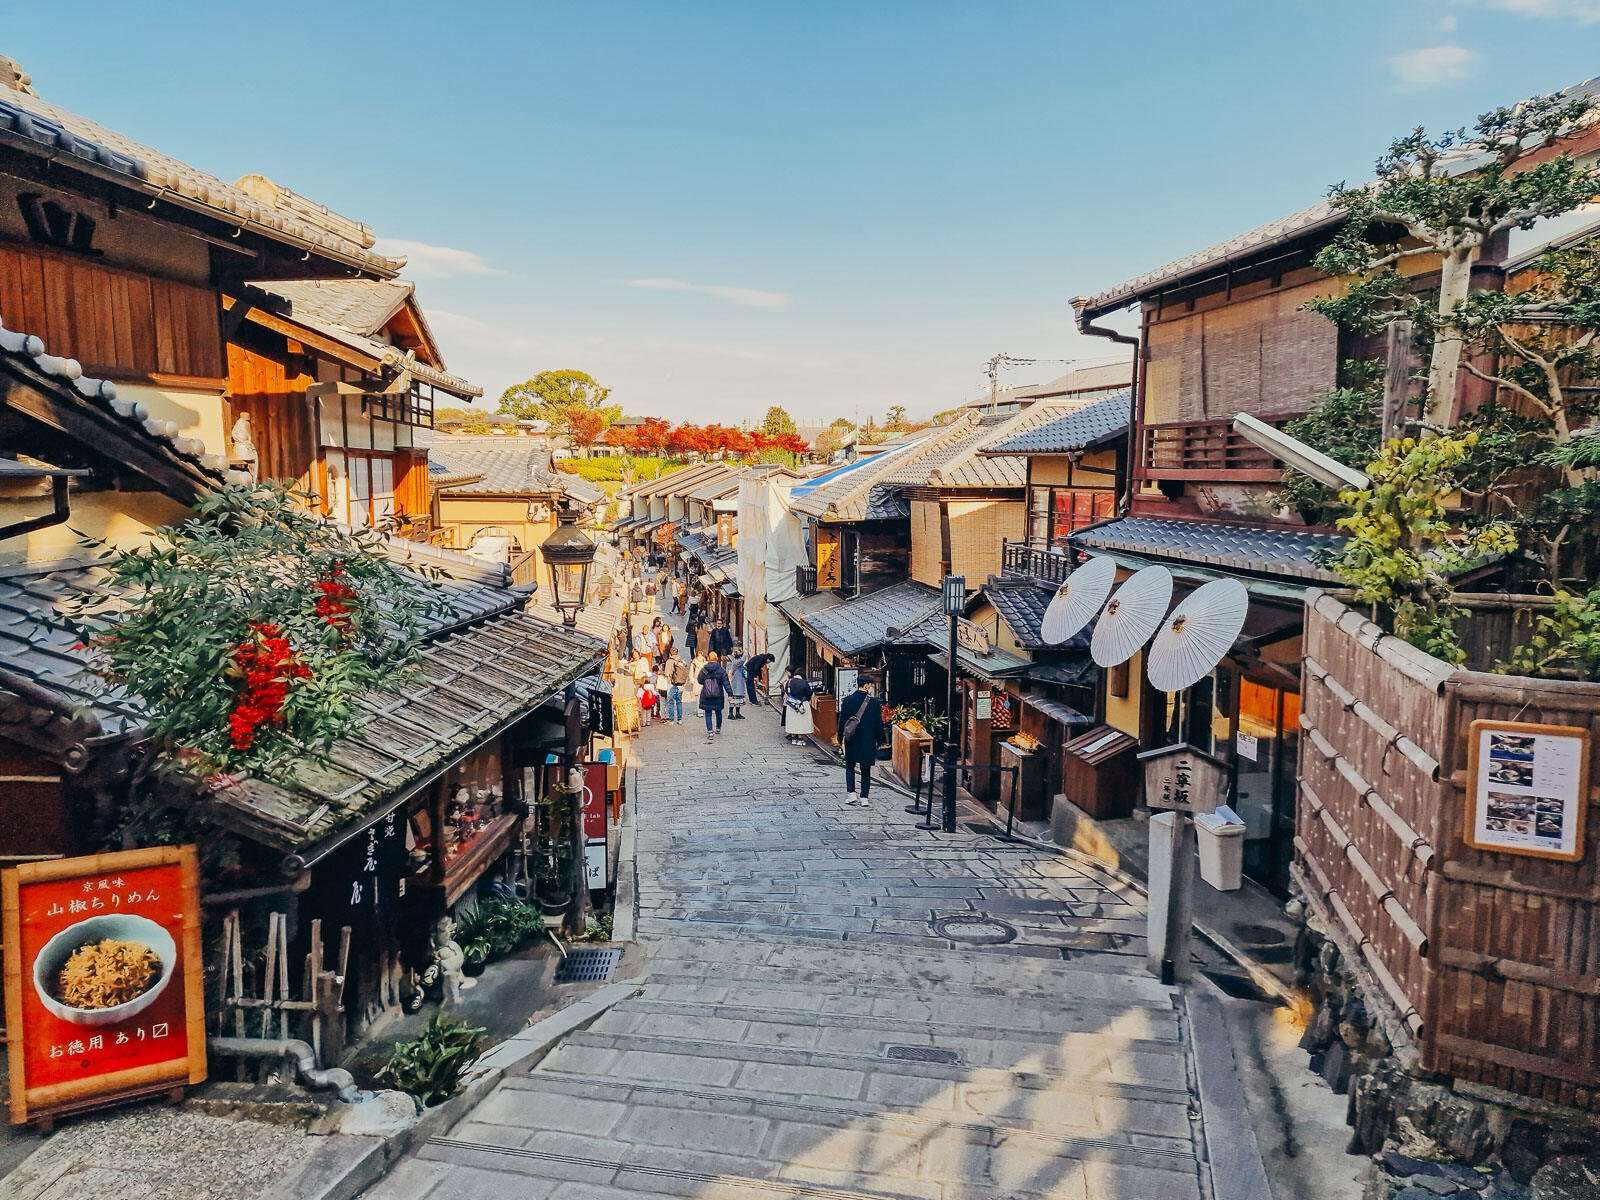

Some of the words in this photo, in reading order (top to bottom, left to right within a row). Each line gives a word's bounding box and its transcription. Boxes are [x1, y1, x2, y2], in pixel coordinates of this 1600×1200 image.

[82, 877, 126, 892] 京風味
[47, 889, 160, 916] 山椒ちりめん
